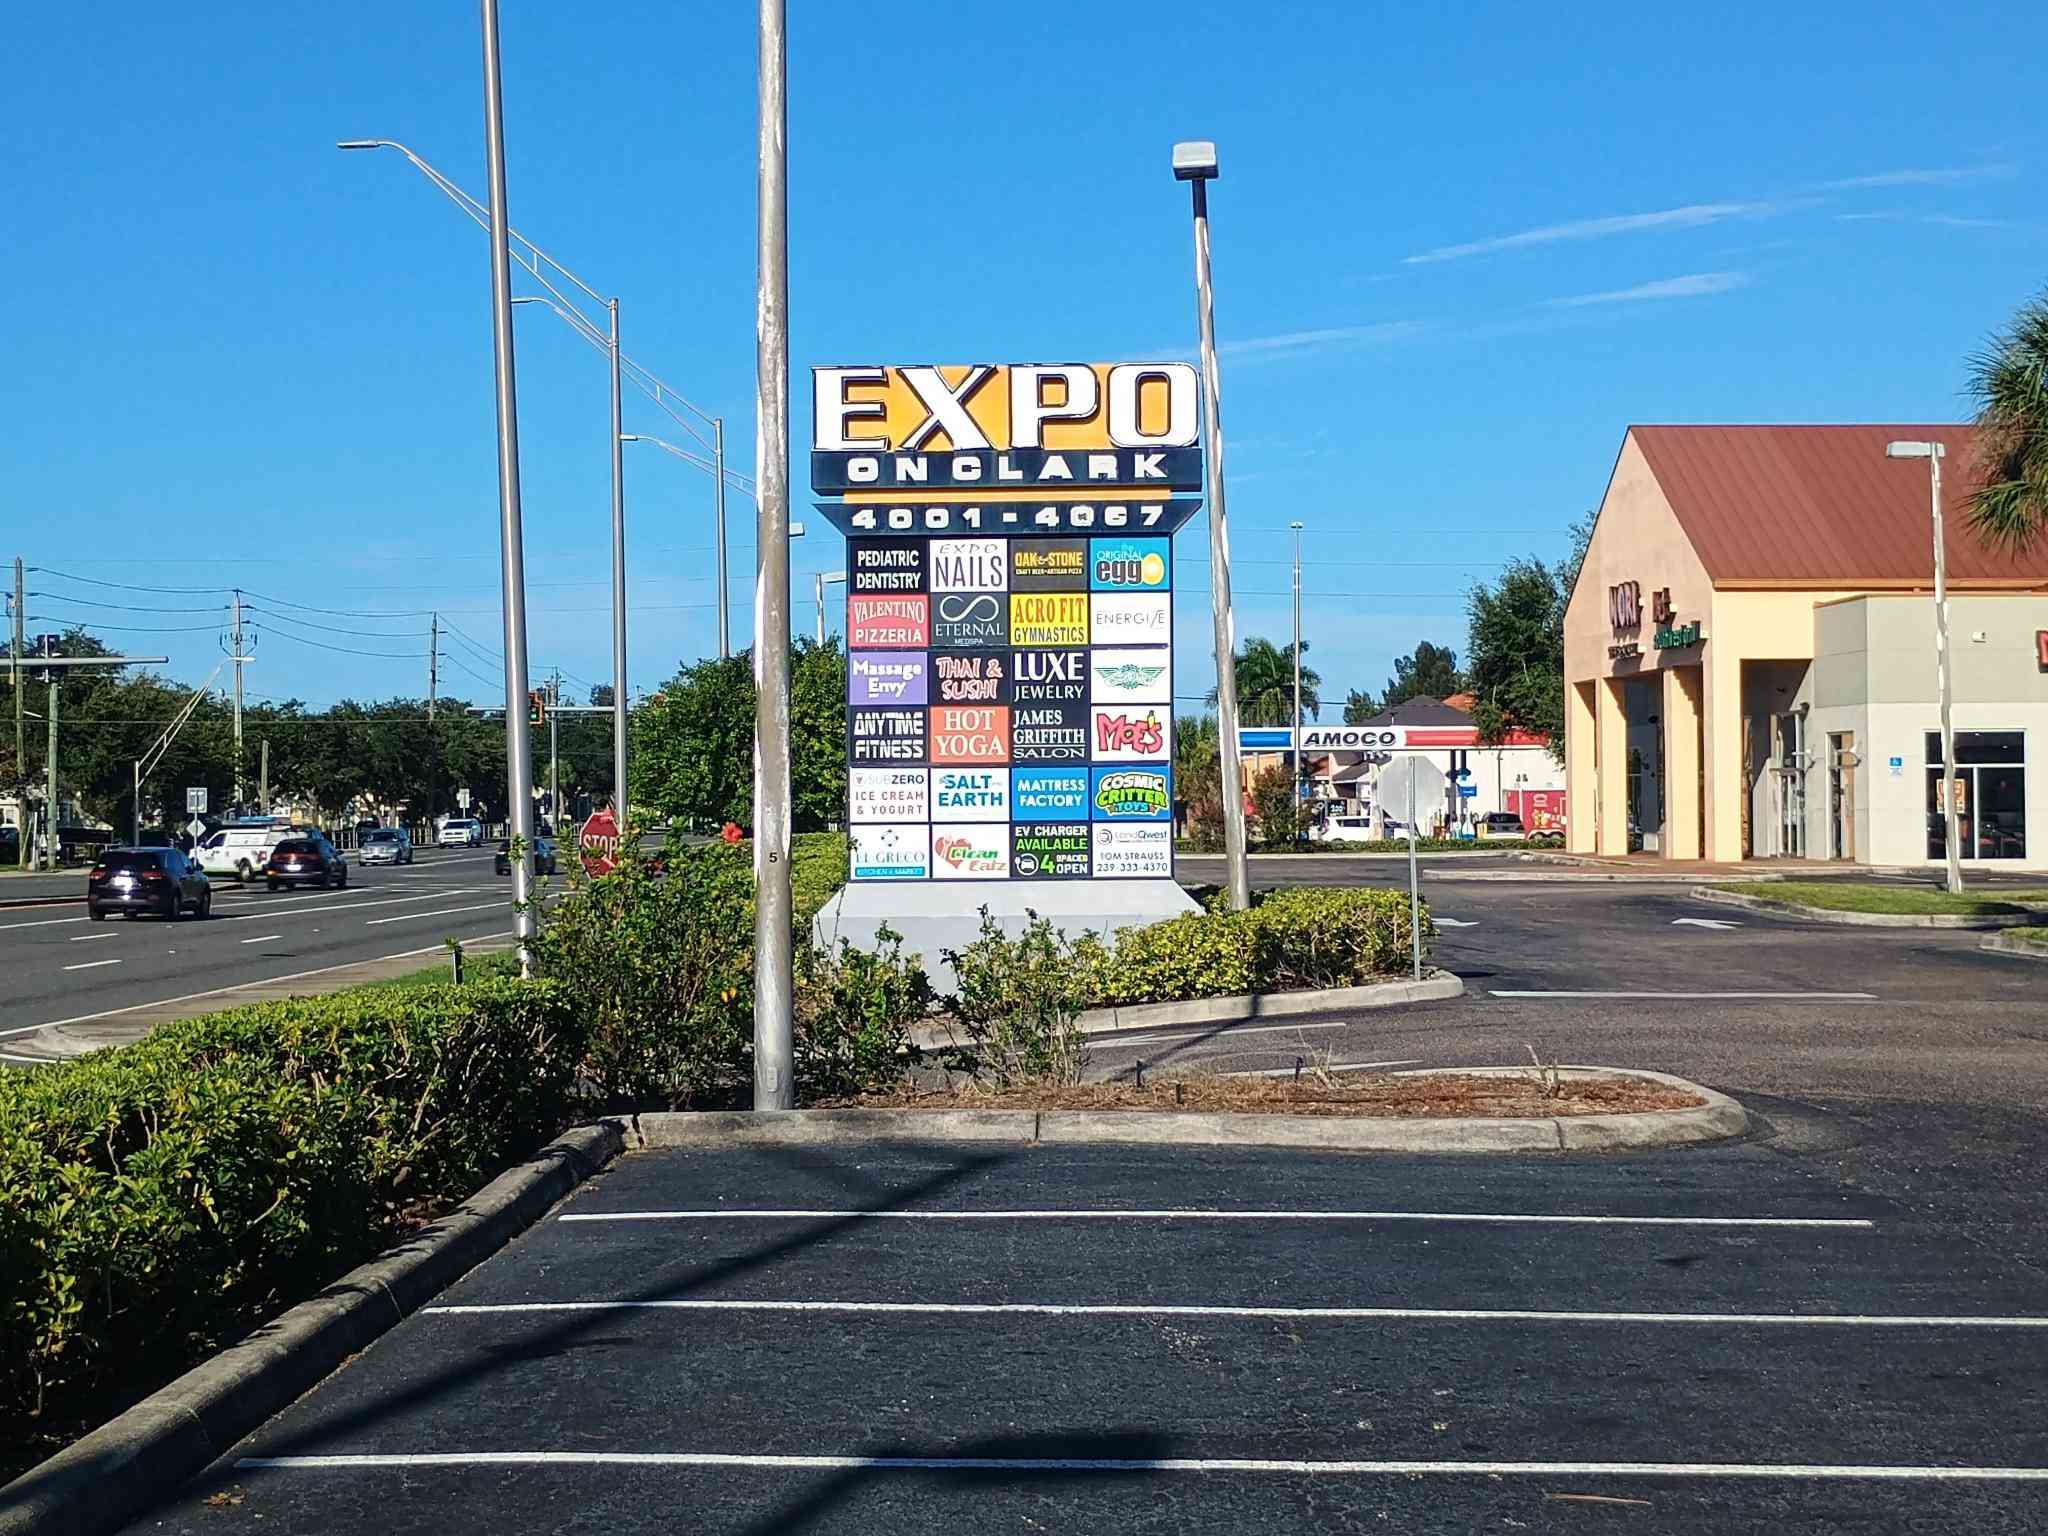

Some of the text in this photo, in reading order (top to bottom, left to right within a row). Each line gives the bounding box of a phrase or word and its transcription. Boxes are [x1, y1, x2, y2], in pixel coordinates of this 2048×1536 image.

[811, 363, 1200, 451] EXPO
[939, 543, 999, 555] EXPO
[1097, 550, 1143, 561] ORIGINAL
[857, 549, 919, 567] PEDIATRIC
[856, 571, 921, 589] DENTISTRY
[935, 556, 1003, 588] NAILS
[853, 600, 925, 625] VALENTINO
[1014, 598, 1085, 623] ACRO FIT
[854, 627, 923, 643] PIZZERIA
[935, 622, 1004, 638] ETERNAL
[1014, 626, 1085, 644] GYMNASTICS
[852, 658, 923, 681] Massage
[935, 656, 1004, 679] THAI &
[1014, 652, 1085, 684] LUXE
[867, 676, 906, 698] Envy
[941, 678, 998, 700] SUSHI
[1013, 685, 1085, 702] JEWELRY
[853, 711, 924, 736] ANYTIME
[944, 709, 994, 731] HOT
[1013, 709, 1063, 729] JAMES
[1013, 728, 1086, 744] GRIFFITH
[1303, 731, 1397, 748] AMOCO
[855, 739, 924, 759] FITNESS
[934, 734, 1006, 757] YOGA
[1013, 747, 1085, 759] SALON
[944, 774, 993, 790] SALT
[1017, 779, 1086, 792] MATTRESS
[1101, 775, 1164, 792] COSMIC
[855, 791, 924, 801] ICE CREAM
[938, 791, 1003, 807] EARTH
[1019, 794, 1082, 807] FACTORY
[1097, 788, 1168, 808] CRITTER
[856, 805, 924, 815] & YOGURT
[1117, 801, 1149, 813] TOYS
[1015, 825, 1088, 837] EV CHARGER
[583, 833, 618, 860] STOP
[1015, 838, 1088, 851] AVAILABLE
[769, 852, 778, 864] 5
[875, 851, 926, 864] GRECO
[1040, 854, 1055, 874] 4
[1100, 852, 1165, 861] TOM STRAUSS
[1056, 863, 1088, 874] OPEN
